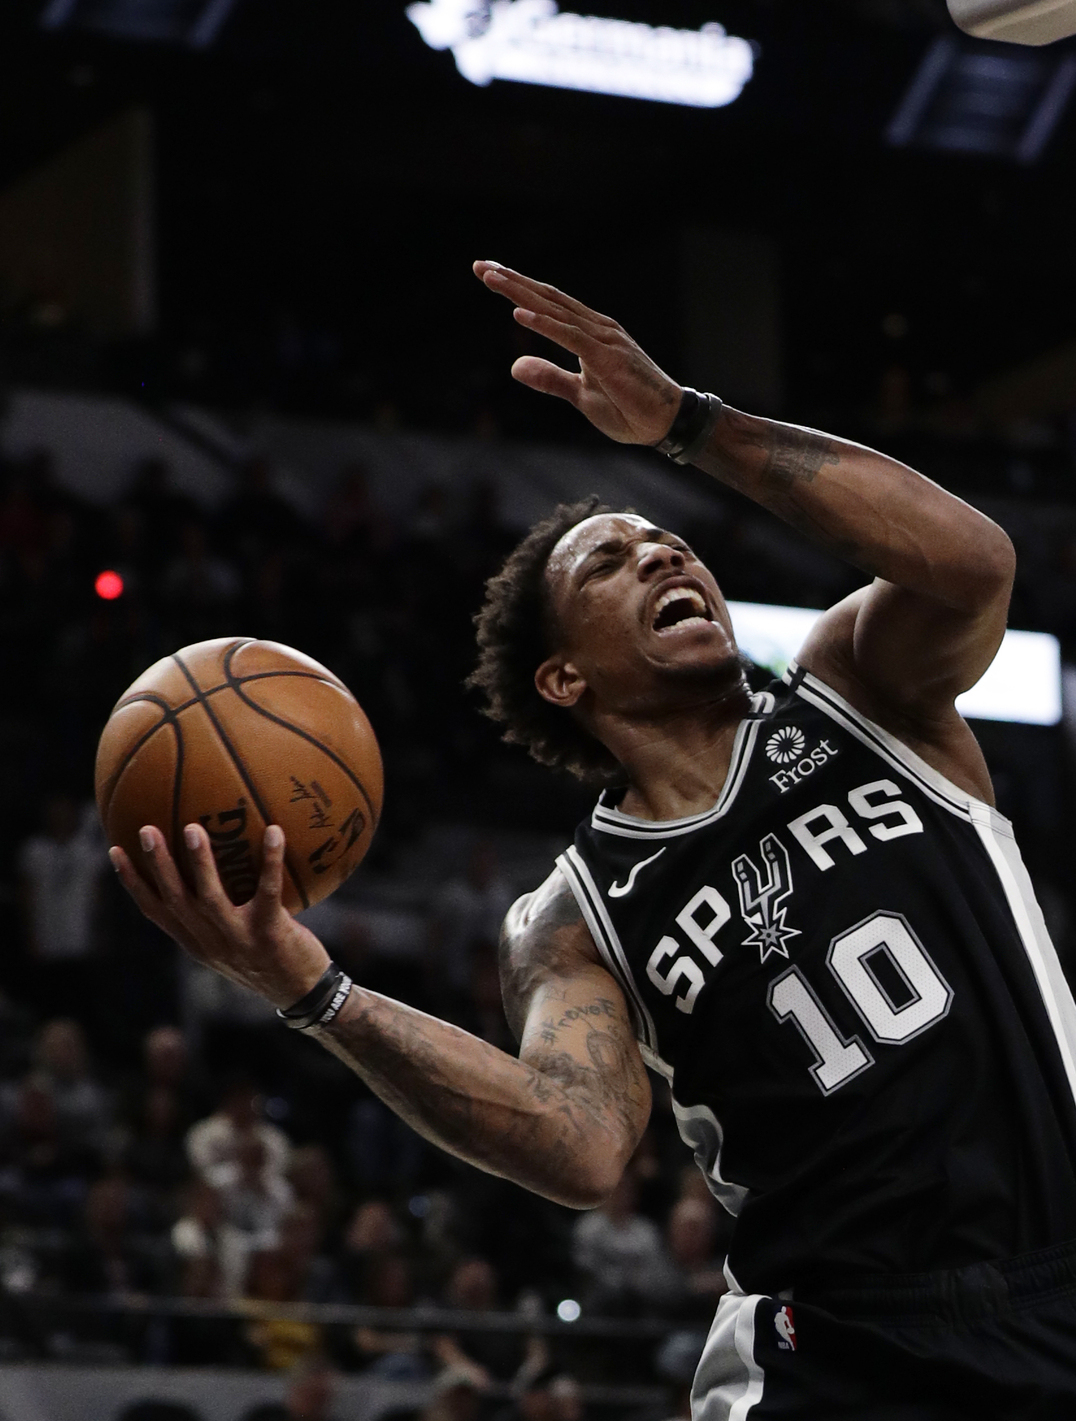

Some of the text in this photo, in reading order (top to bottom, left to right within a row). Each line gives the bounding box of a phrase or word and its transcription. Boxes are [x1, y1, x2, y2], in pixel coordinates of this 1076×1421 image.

[768, 739, 839, 794] Frost
[645, 778, 925, 1015] SPURS
[765, 908, 955, 1097] 10
